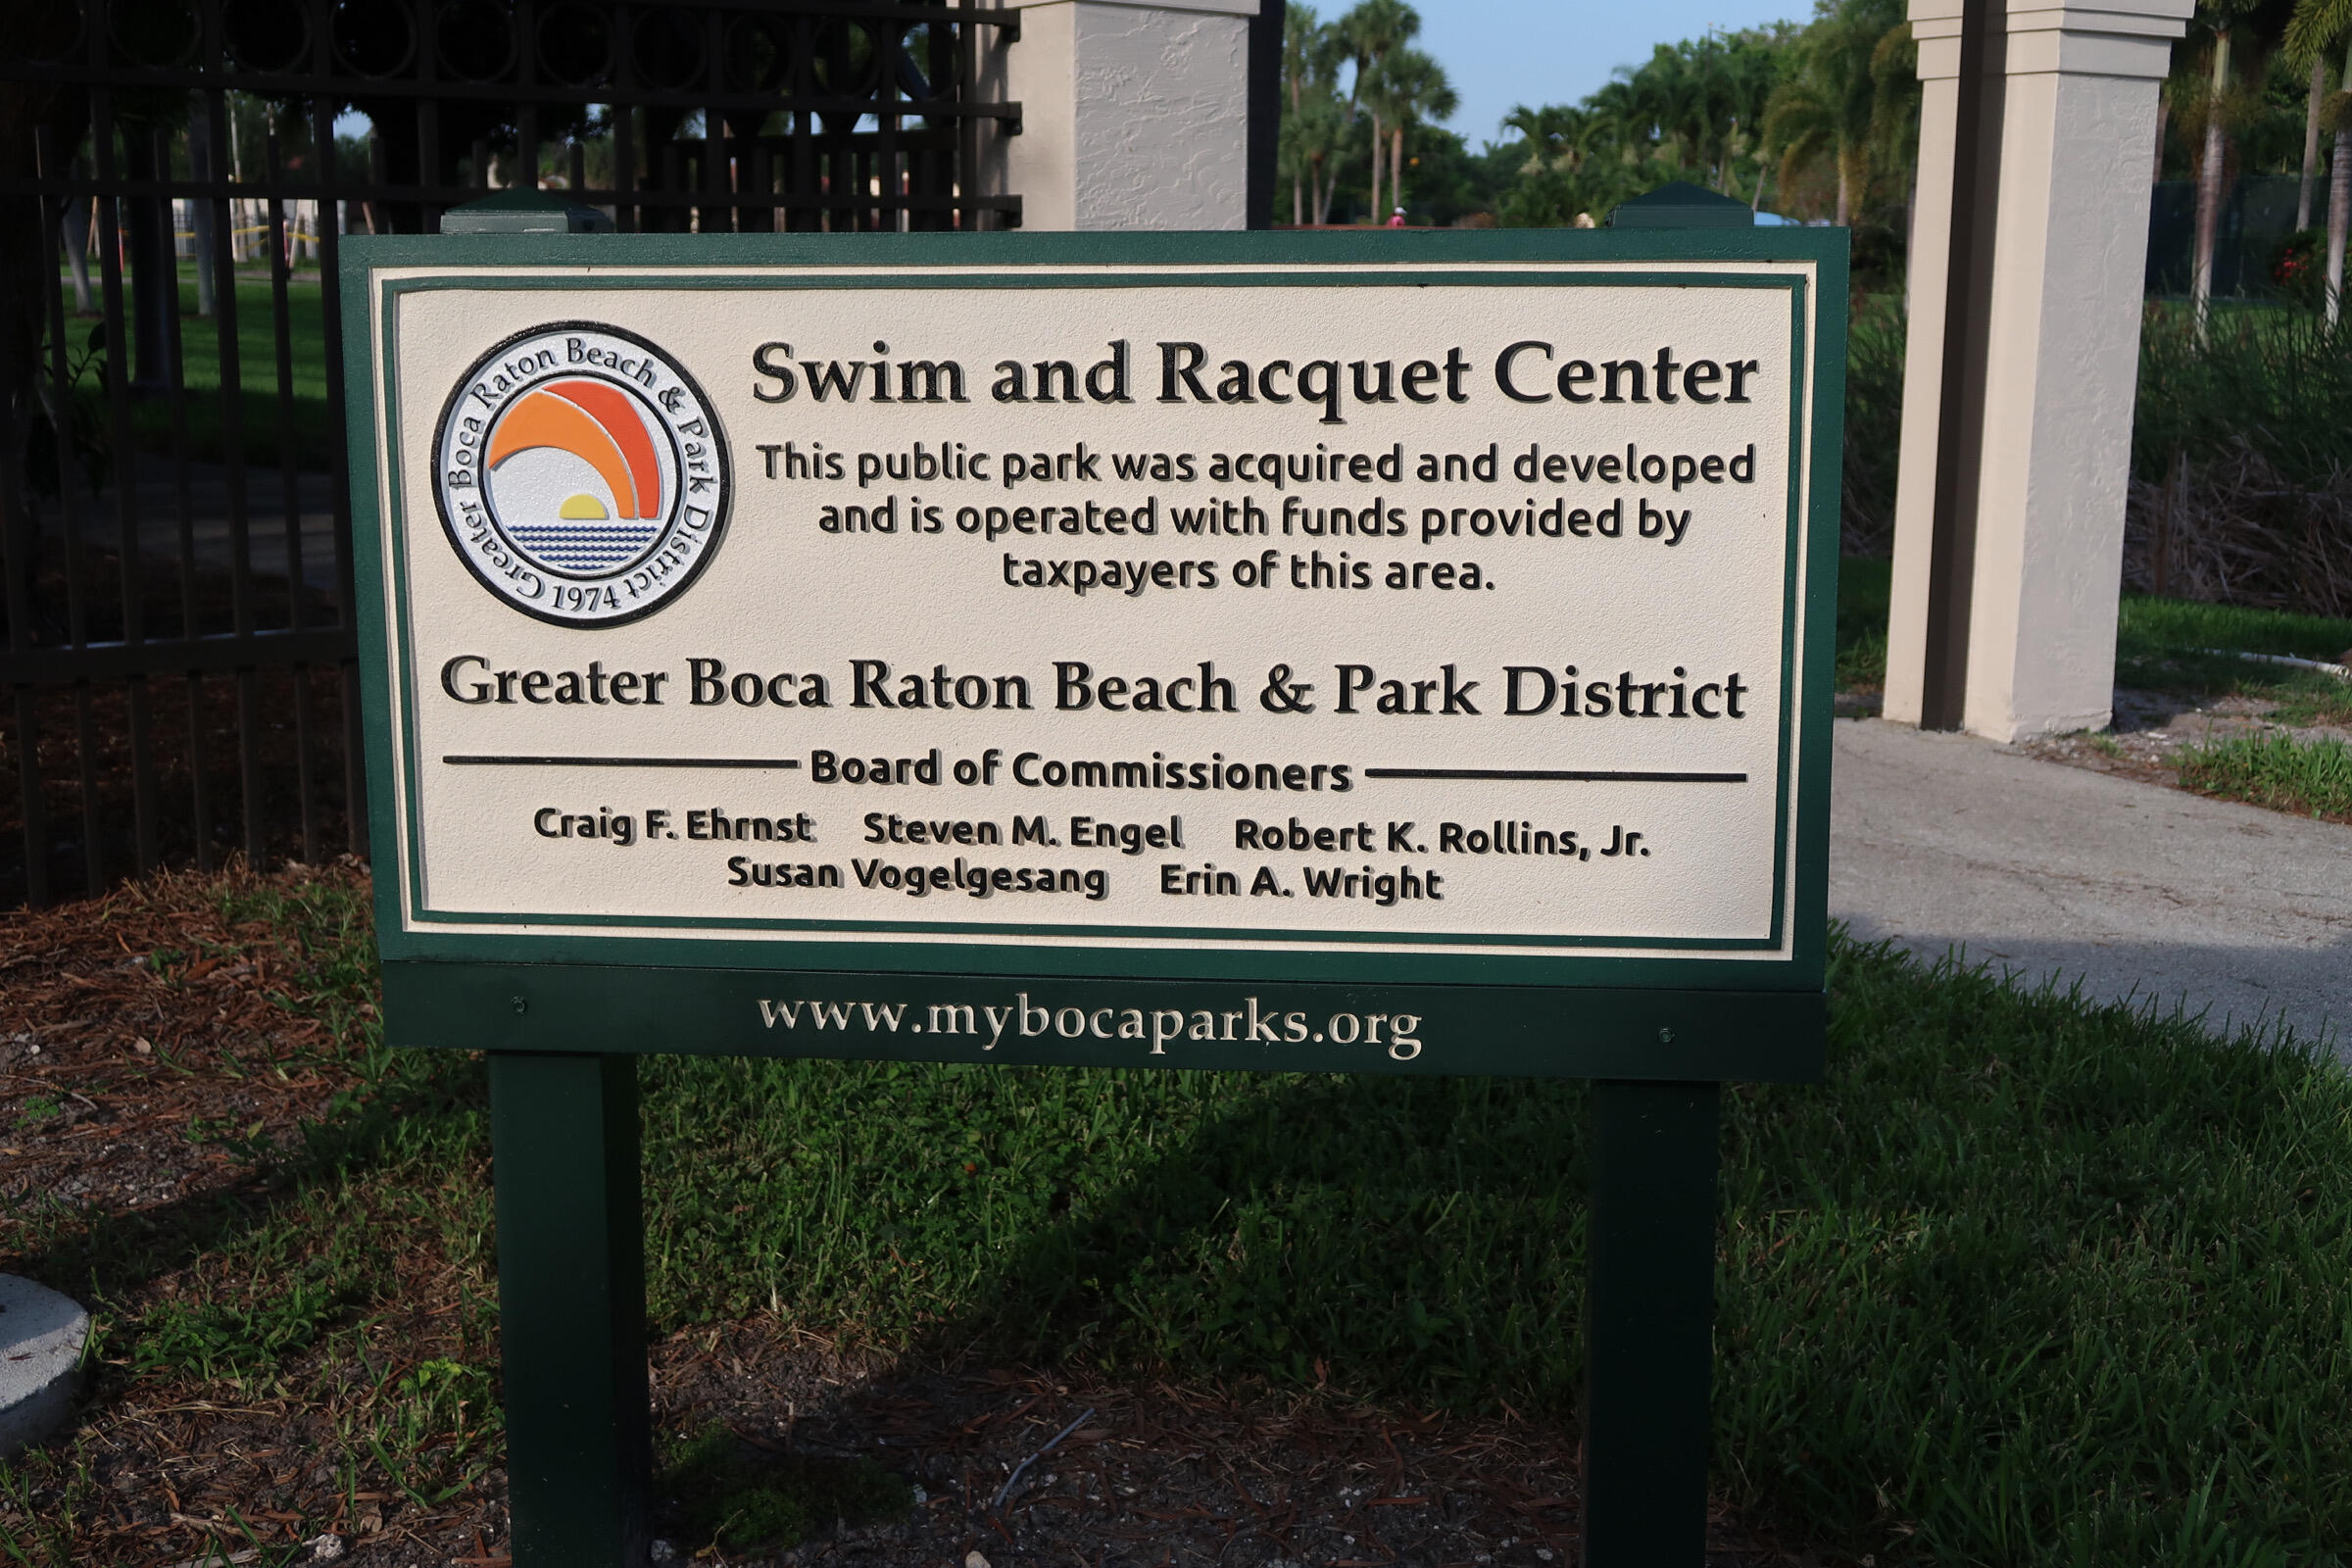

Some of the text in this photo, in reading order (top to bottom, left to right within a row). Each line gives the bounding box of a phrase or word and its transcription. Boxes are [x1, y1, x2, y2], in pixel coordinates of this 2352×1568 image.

[754, 340, 1756, 424] Swim and Racquet Center
[448, 337, 717, 599] Greater Boca Raton Beach & Park District
[757, 441, 1754, 491] This public park was acquired and developed
[819, 495, 1690, 546] and is operated with funds provided by
[1004, 550, 1494, 595] taxpayers of this area.
[552, 584, 619, 611] 1974
[441, 655, 1747, 719] Greater Boca Raton Beach & Park District
[812, 748, 1350, 792] Board of Commissioners
[535, 807, 811, 846] Craig F. Ehrnst
[864, 812, 1181, 856] Steven M. Engel
[1236, 817, 1649, 860] Robert K. Rollins, Jr.
[728, 857, 1105, 900] Susan Vogelgesang
[1161, 863, 1443, 906] Erin A. Wright
[760, 993, 1423, 1060] www.mybocaparks.org
